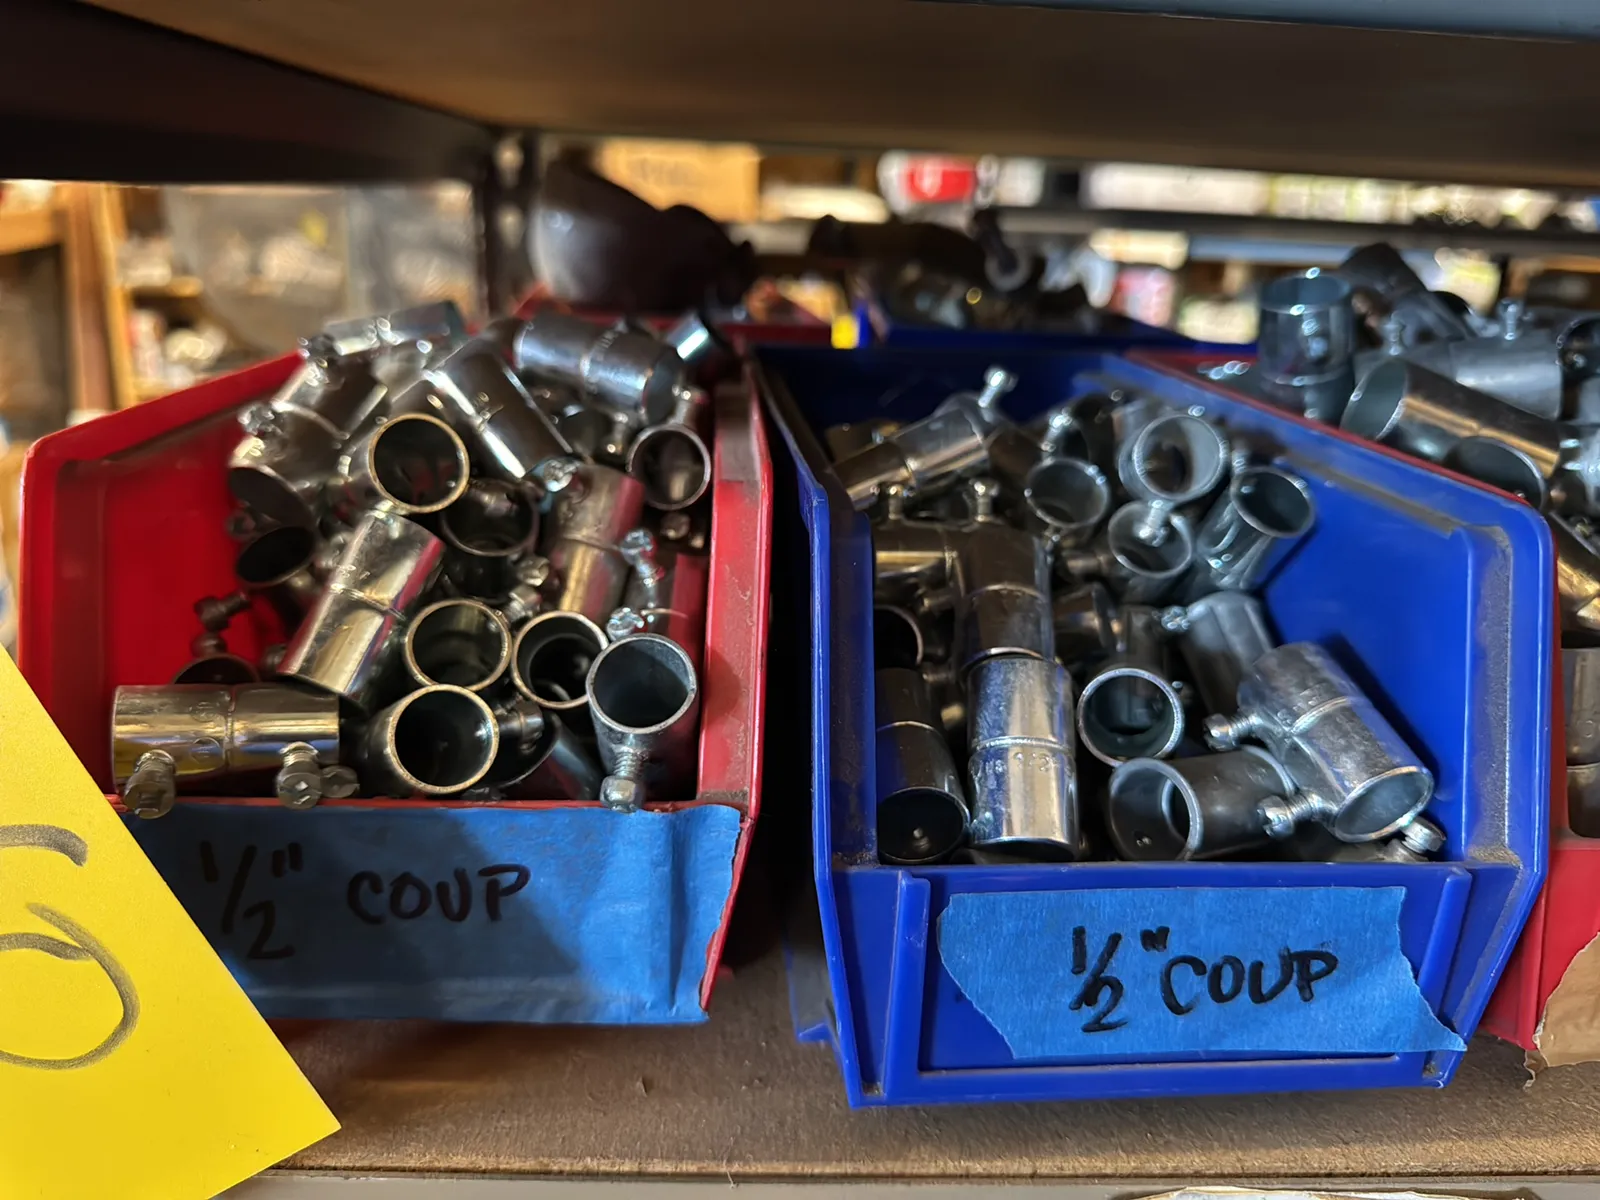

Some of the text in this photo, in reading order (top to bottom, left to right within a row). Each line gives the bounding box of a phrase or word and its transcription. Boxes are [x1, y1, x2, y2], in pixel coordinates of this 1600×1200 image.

[347, 862, 532, 925] COUP
[1068, 925, 1339, 1033] 1/2" COUP
